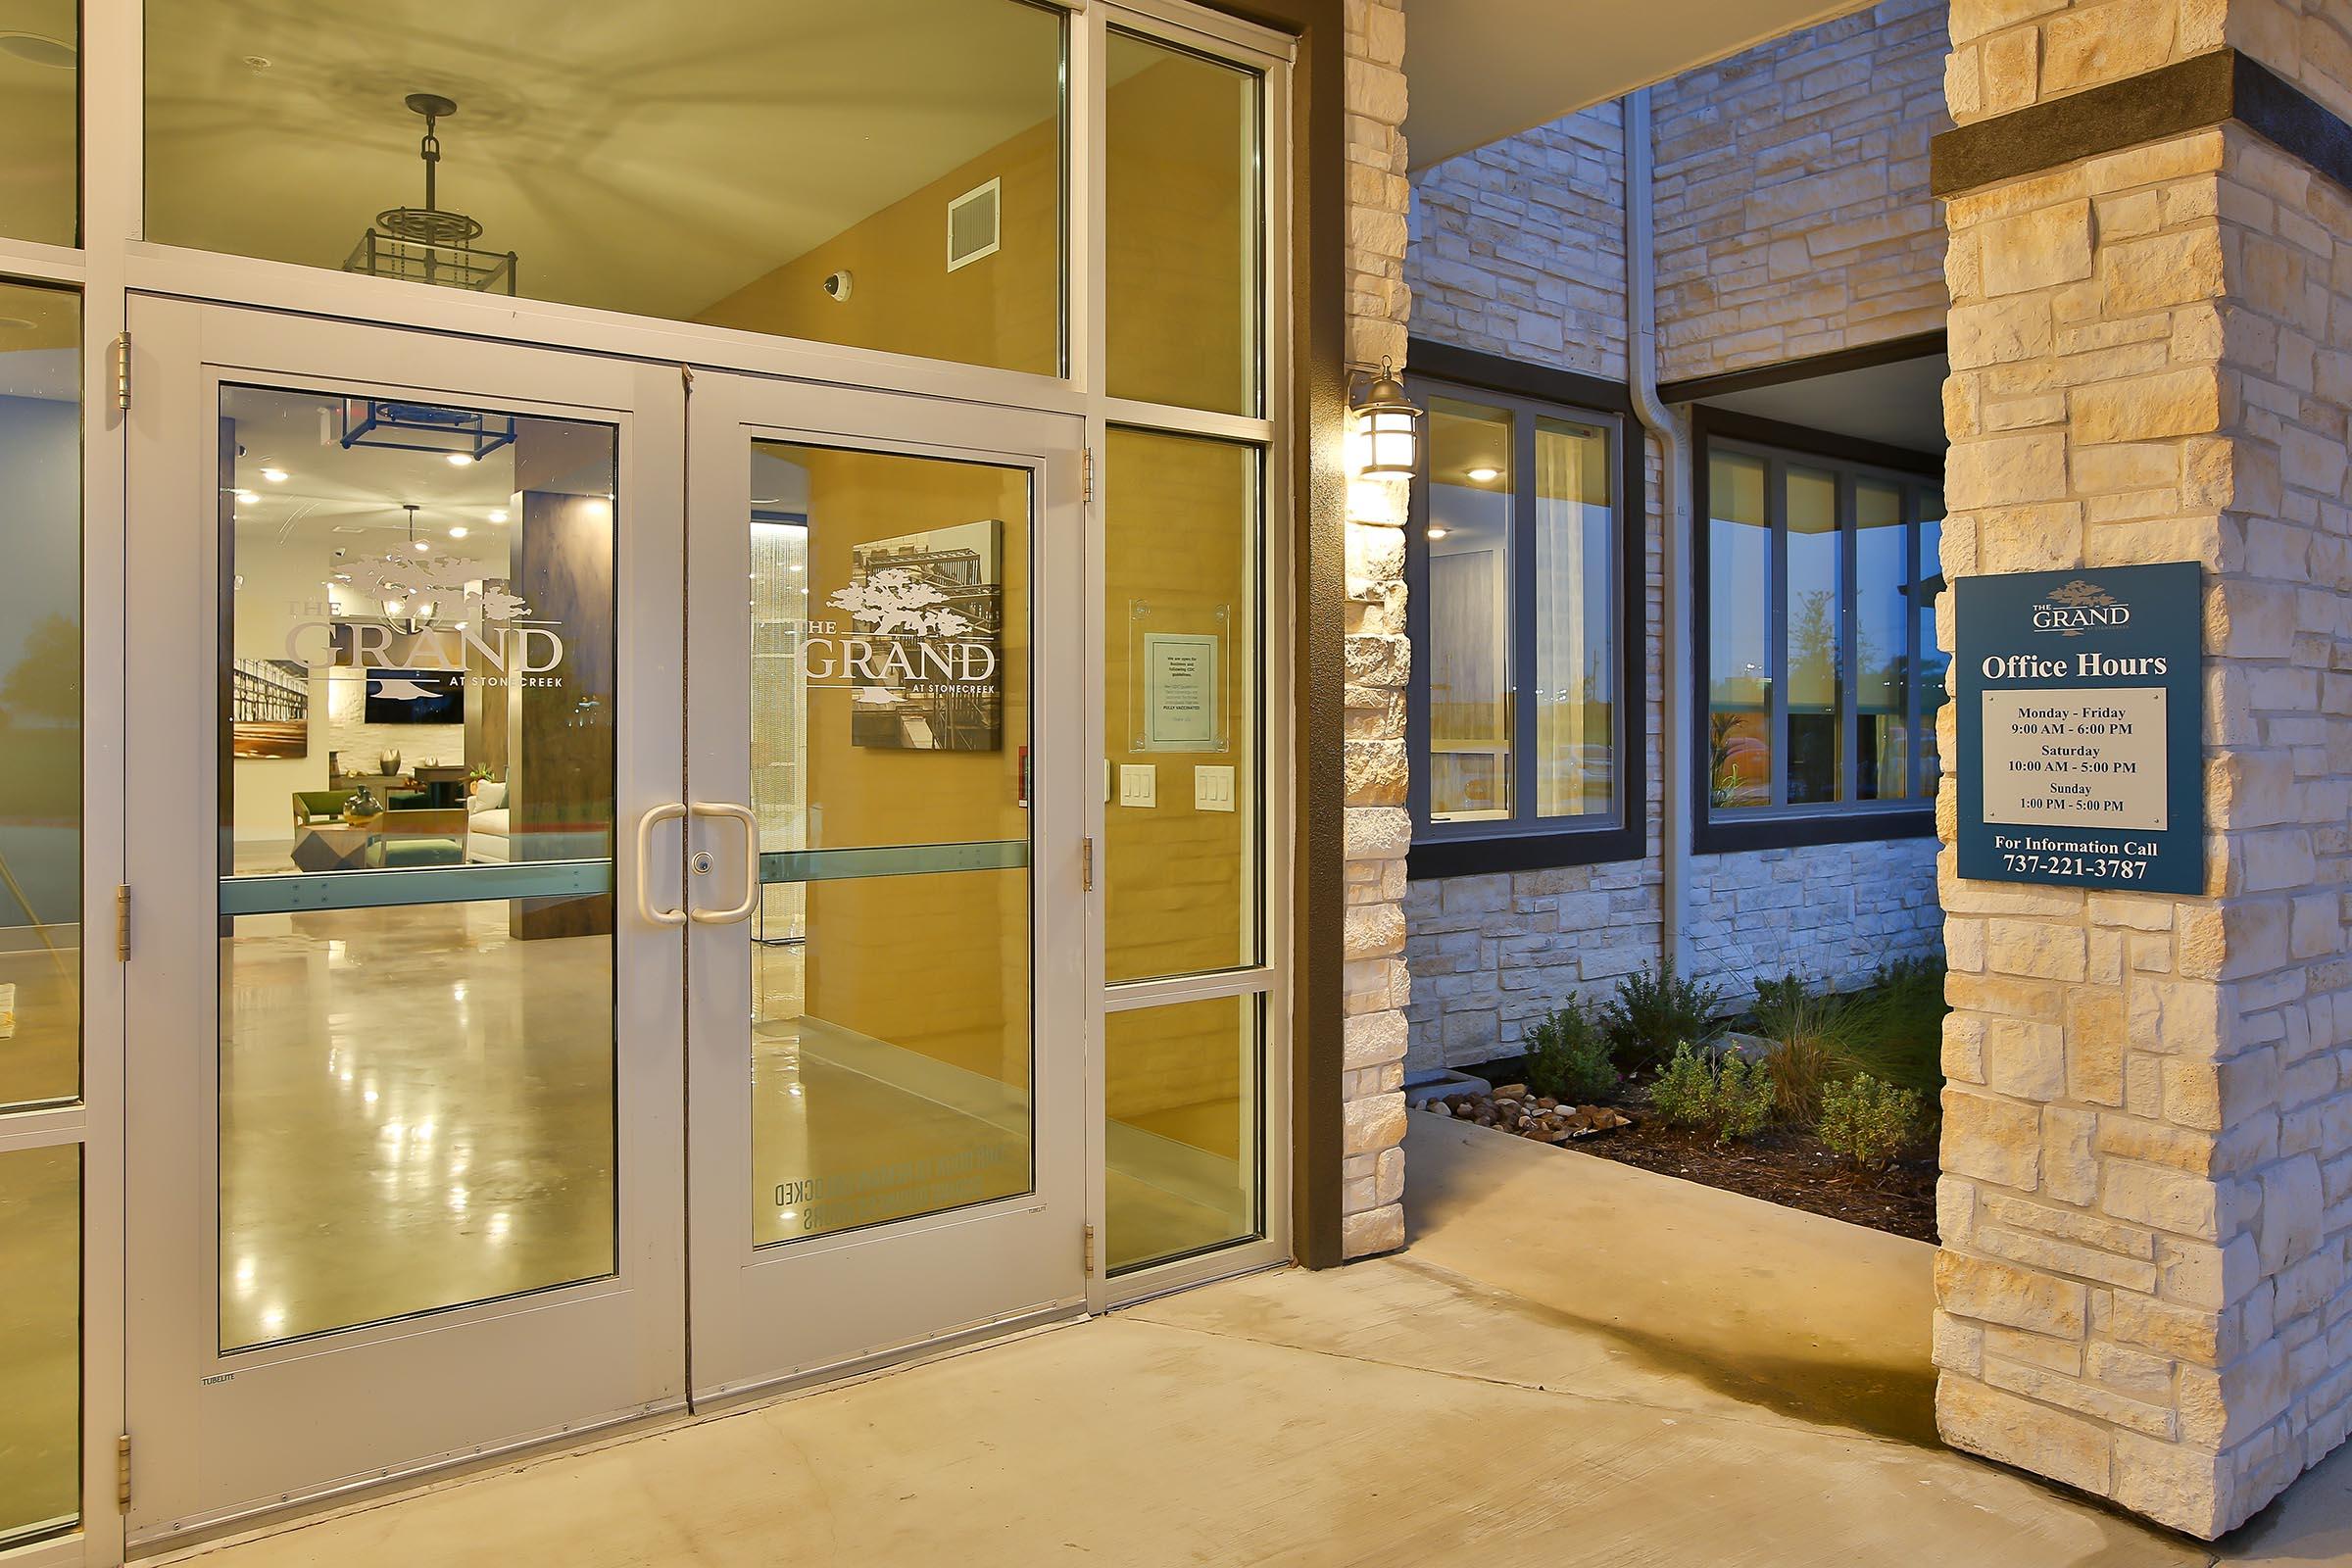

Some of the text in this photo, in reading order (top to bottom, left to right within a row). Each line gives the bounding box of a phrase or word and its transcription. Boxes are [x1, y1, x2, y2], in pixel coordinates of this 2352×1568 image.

[2032, 607, 2131, 629] GRAND
[794, 618, 838, 635] THE
[284, 621, 564, 673] GRAND
[798, 637, 997, 681] GRAND
[1982, 652, 2168, 679] Office Hours
[449, 676, 564, 688] AT STONECREEK
[911, 683, 996, 694] AT STONECREEK
[2018, 707, 2070, 721] Monday
[2082, 707, 2127, 721] Friday
[2011, 723, 2038, 735] 9:00
[2040, 723, 2065, 735] AM
[2077, 723, 2105, 735] 6:00
[2109, 723, 2133, 735] PM
[2040, 745, 2101, 760] Saturday
[2008, 760, 2041, 772] 10:00
[2044, 760, 2069, 772] AM
[2081, 761, 2109, 773] 5:00
[2113, 761, 2136, 773] PM
[2049, 782, 2092, 797] Sunday
[2020, 798, 2043, 809] 1:00
[2046, 799, 2066, 809] PM
[2076, 800, 2100, 811] 5:00
[2103, 800, 2125, 812] PM
[1994, 835, 2159, 857] For Information Call
[2002, 854, 2147, 880] 737-221-3787
[202, 1373, 235, 1385] TUBELITE
